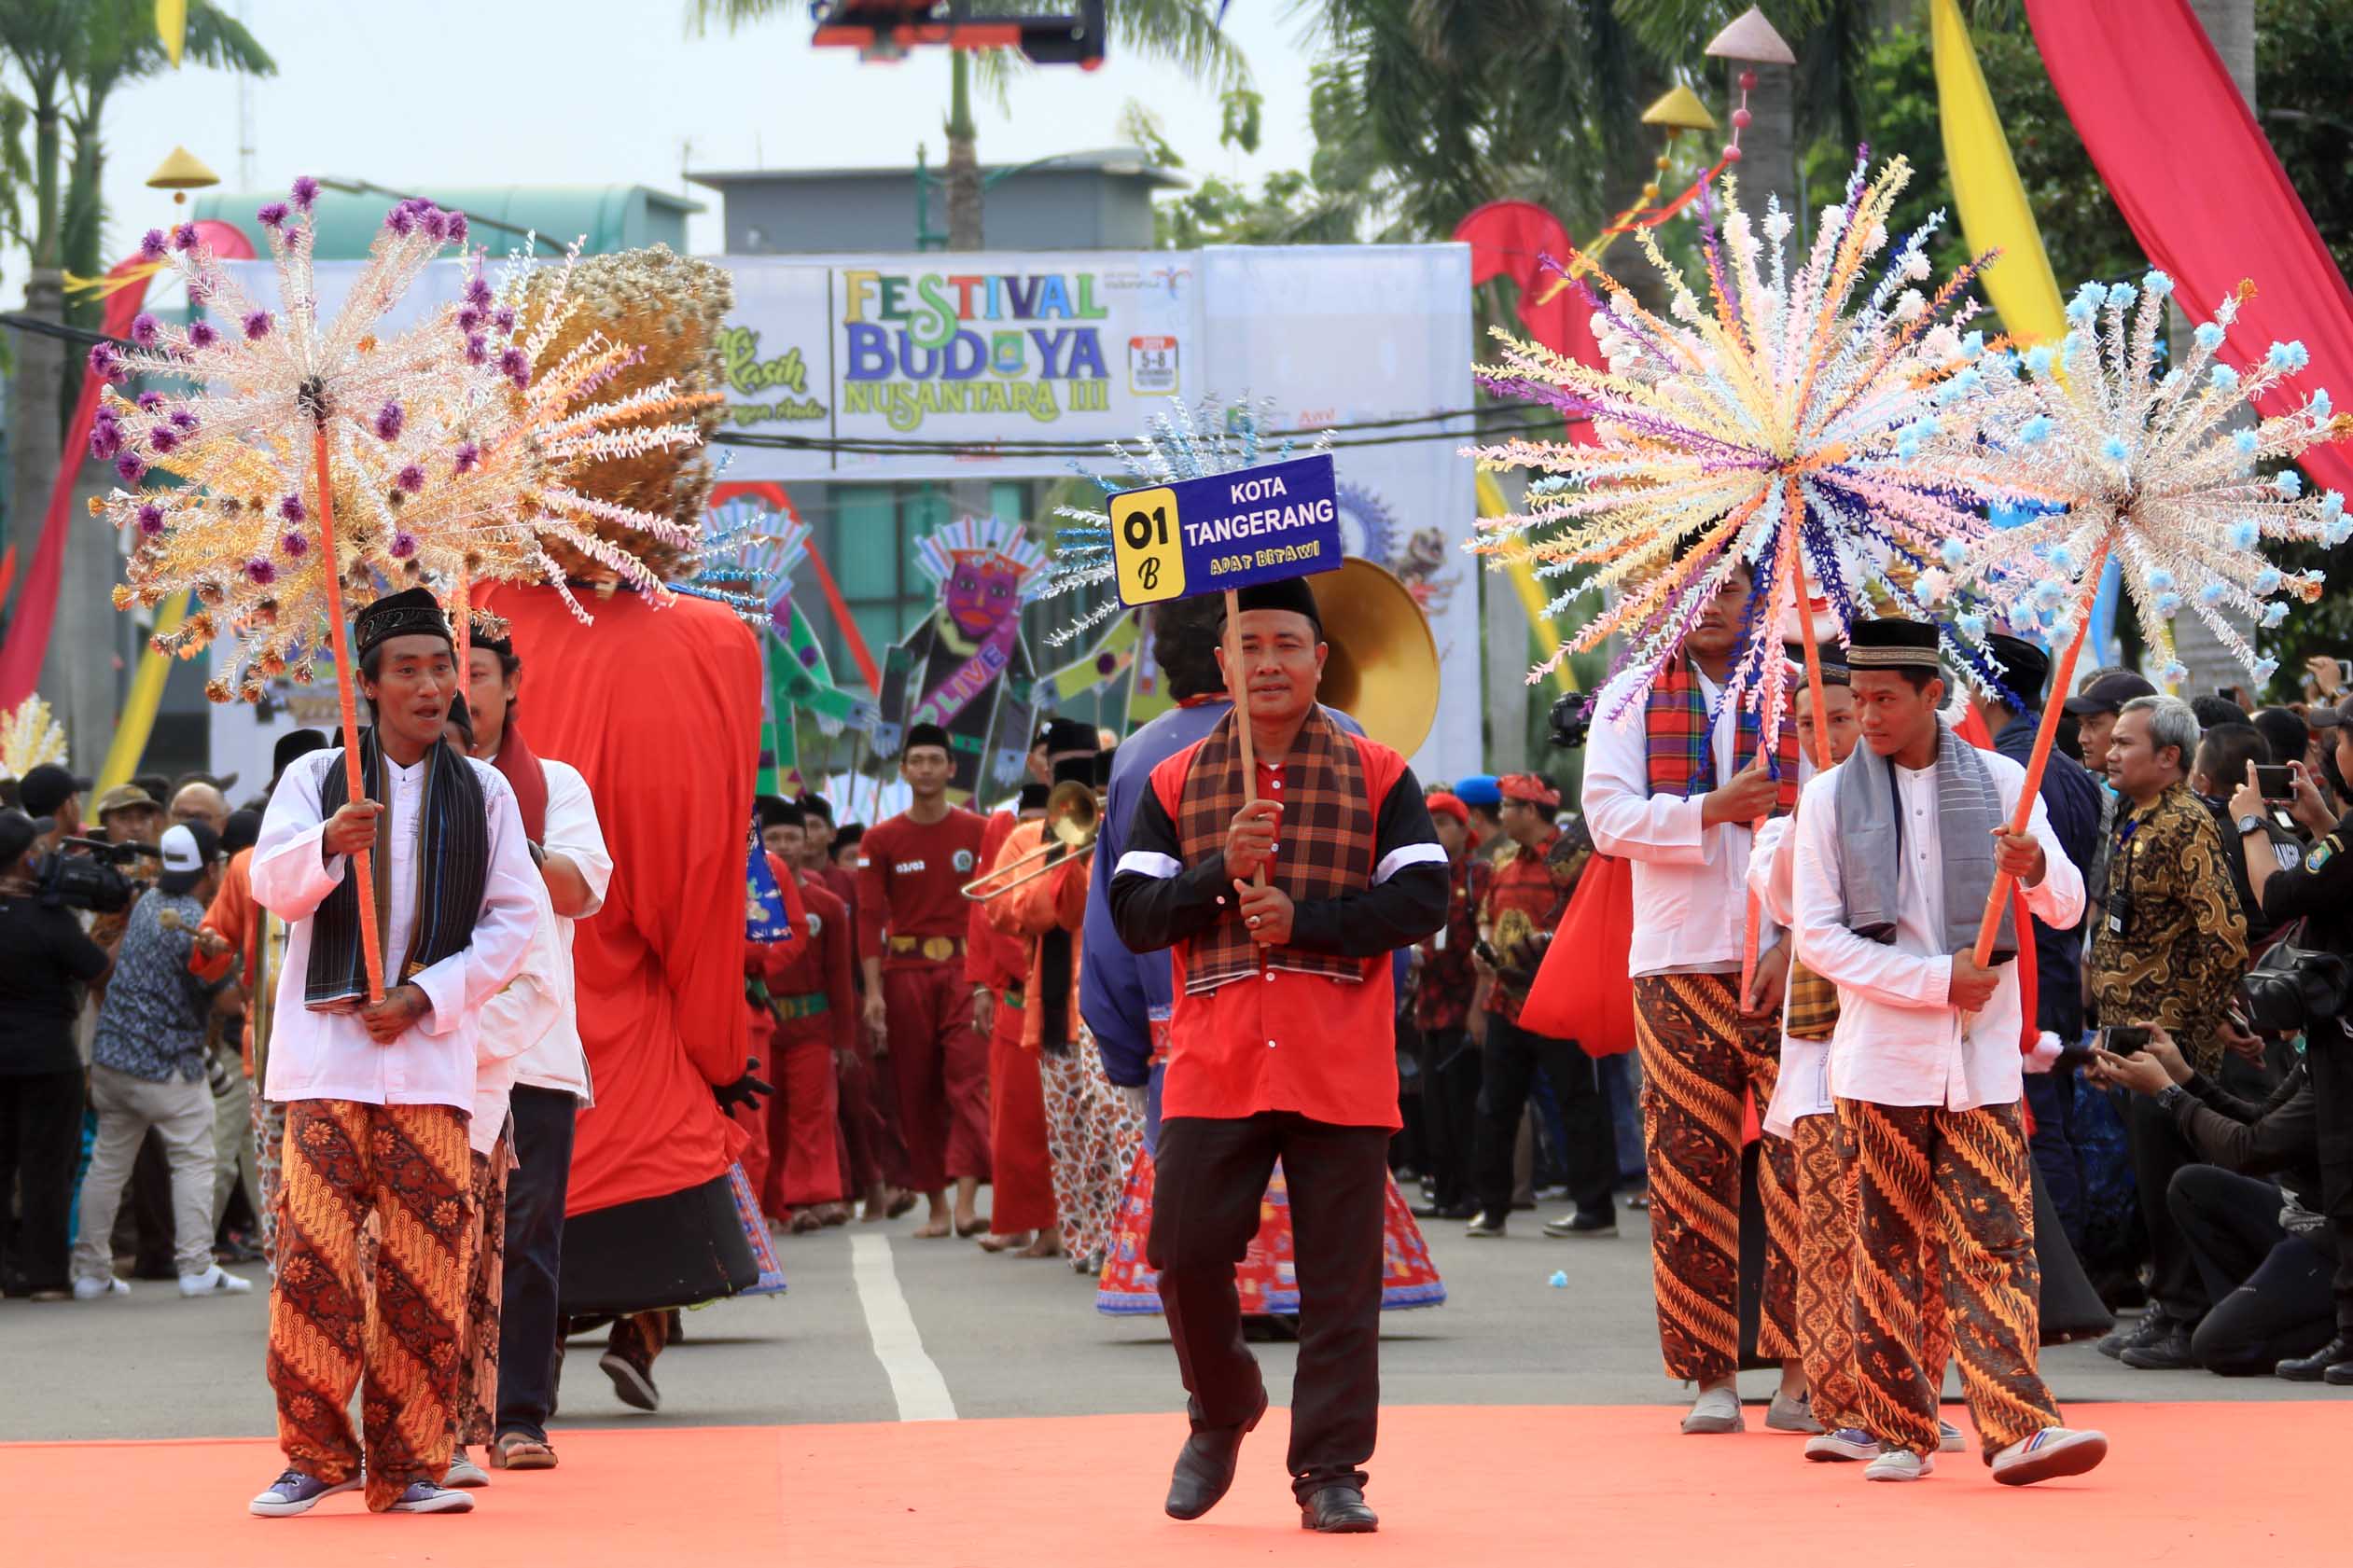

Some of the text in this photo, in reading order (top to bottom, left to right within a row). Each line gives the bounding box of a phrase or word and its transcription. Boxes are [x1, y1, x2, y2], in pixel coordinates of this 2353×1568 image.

[843, 271, 1108, 349] FESTIVAL
[843, 322, 1110, 381] BUDYA
[843, 380, 1110, 432] NUSANTARA III
[1231, 476, 1288, 505] KOTA
[1123, 506, 1169, 550] 01
[1184, 499, 1334, 547] TANGERANG
[1137, 557, 1161, 590] B
[1210, 540, 1320, 576] ADAT BETAWI
